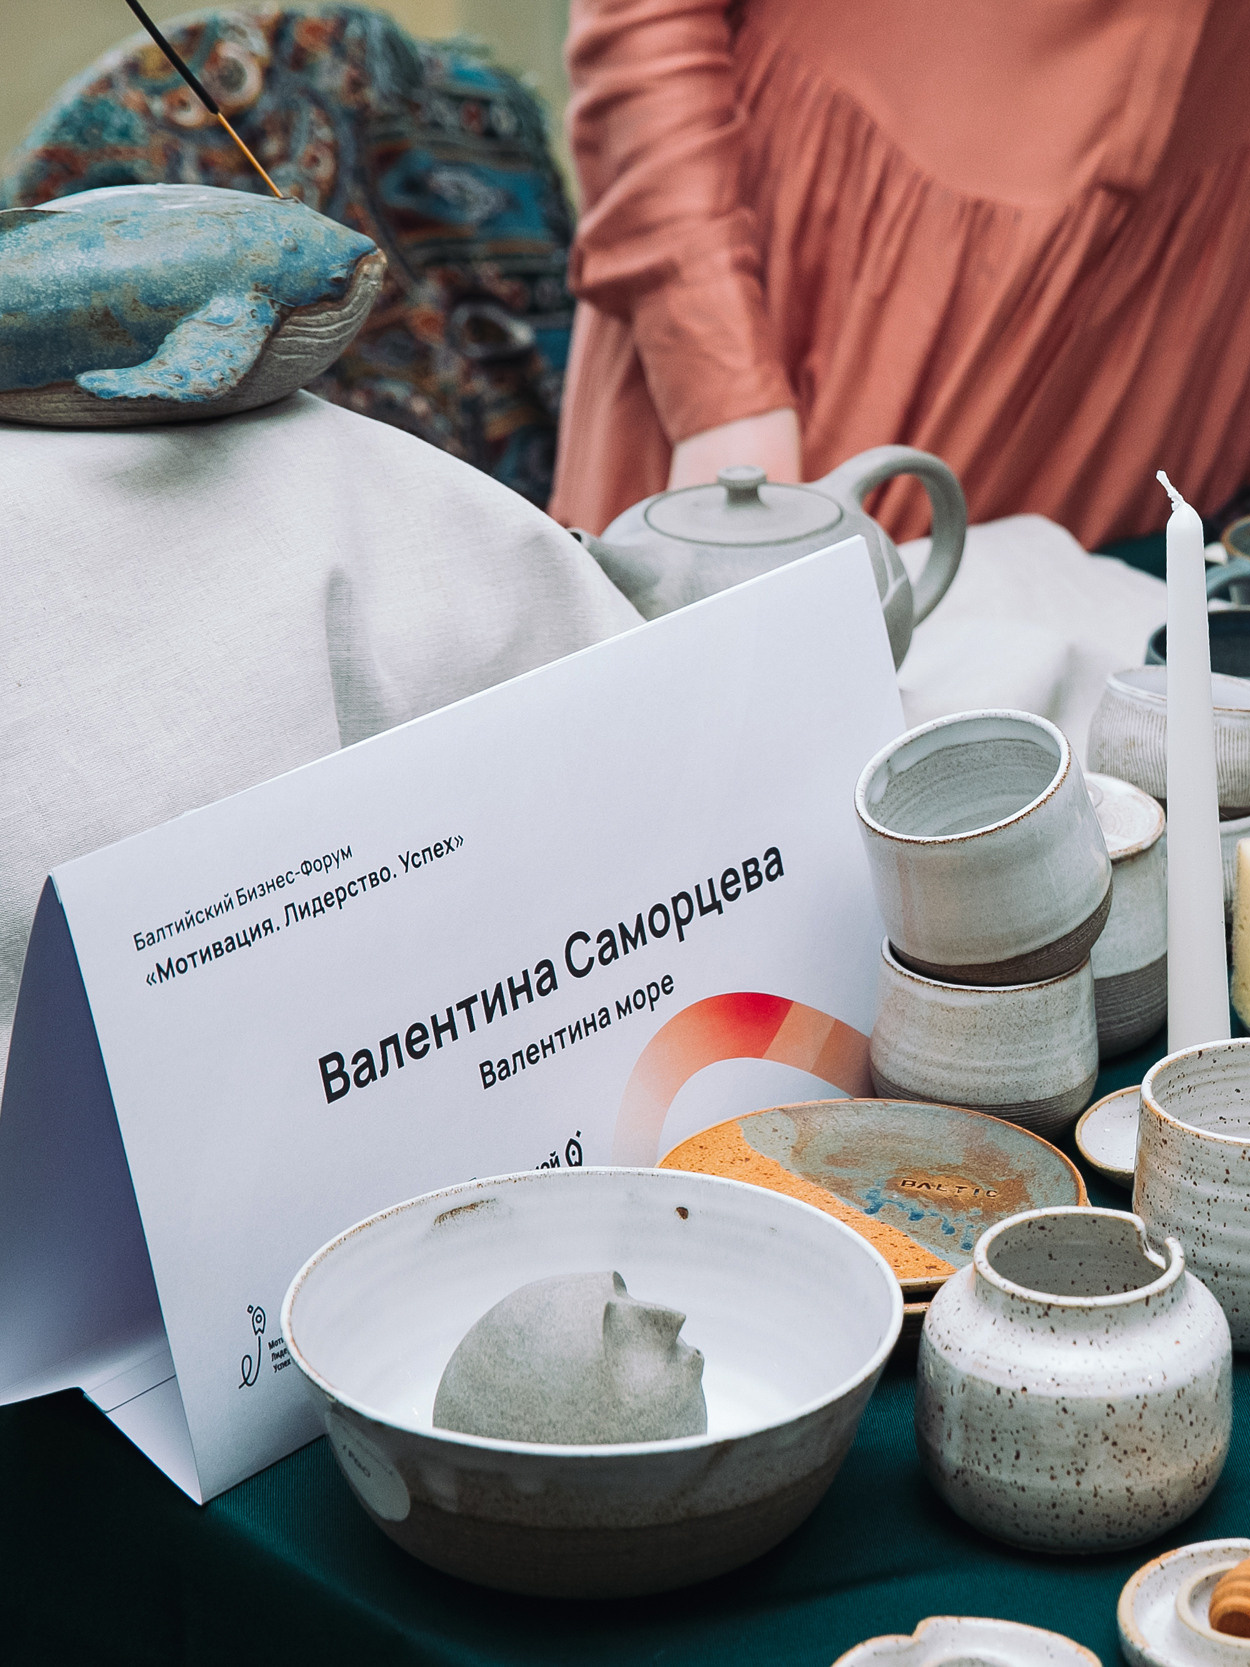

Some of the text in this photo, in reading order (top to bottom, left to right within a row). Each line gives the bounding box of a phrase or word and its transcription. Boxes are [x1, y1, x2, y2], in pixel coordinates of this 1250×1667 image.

[133, 845, 354, 951] Балтийский Бизнес-Форум
[145, 834, 464, 987] «Мотивация. Лидерство. Успех»
[318, 846, 785, 1104] Валентина Саморцева
[478, 974, 675, 1090] Валентина море
[900, 1178, 999, 1199] BALTIC
